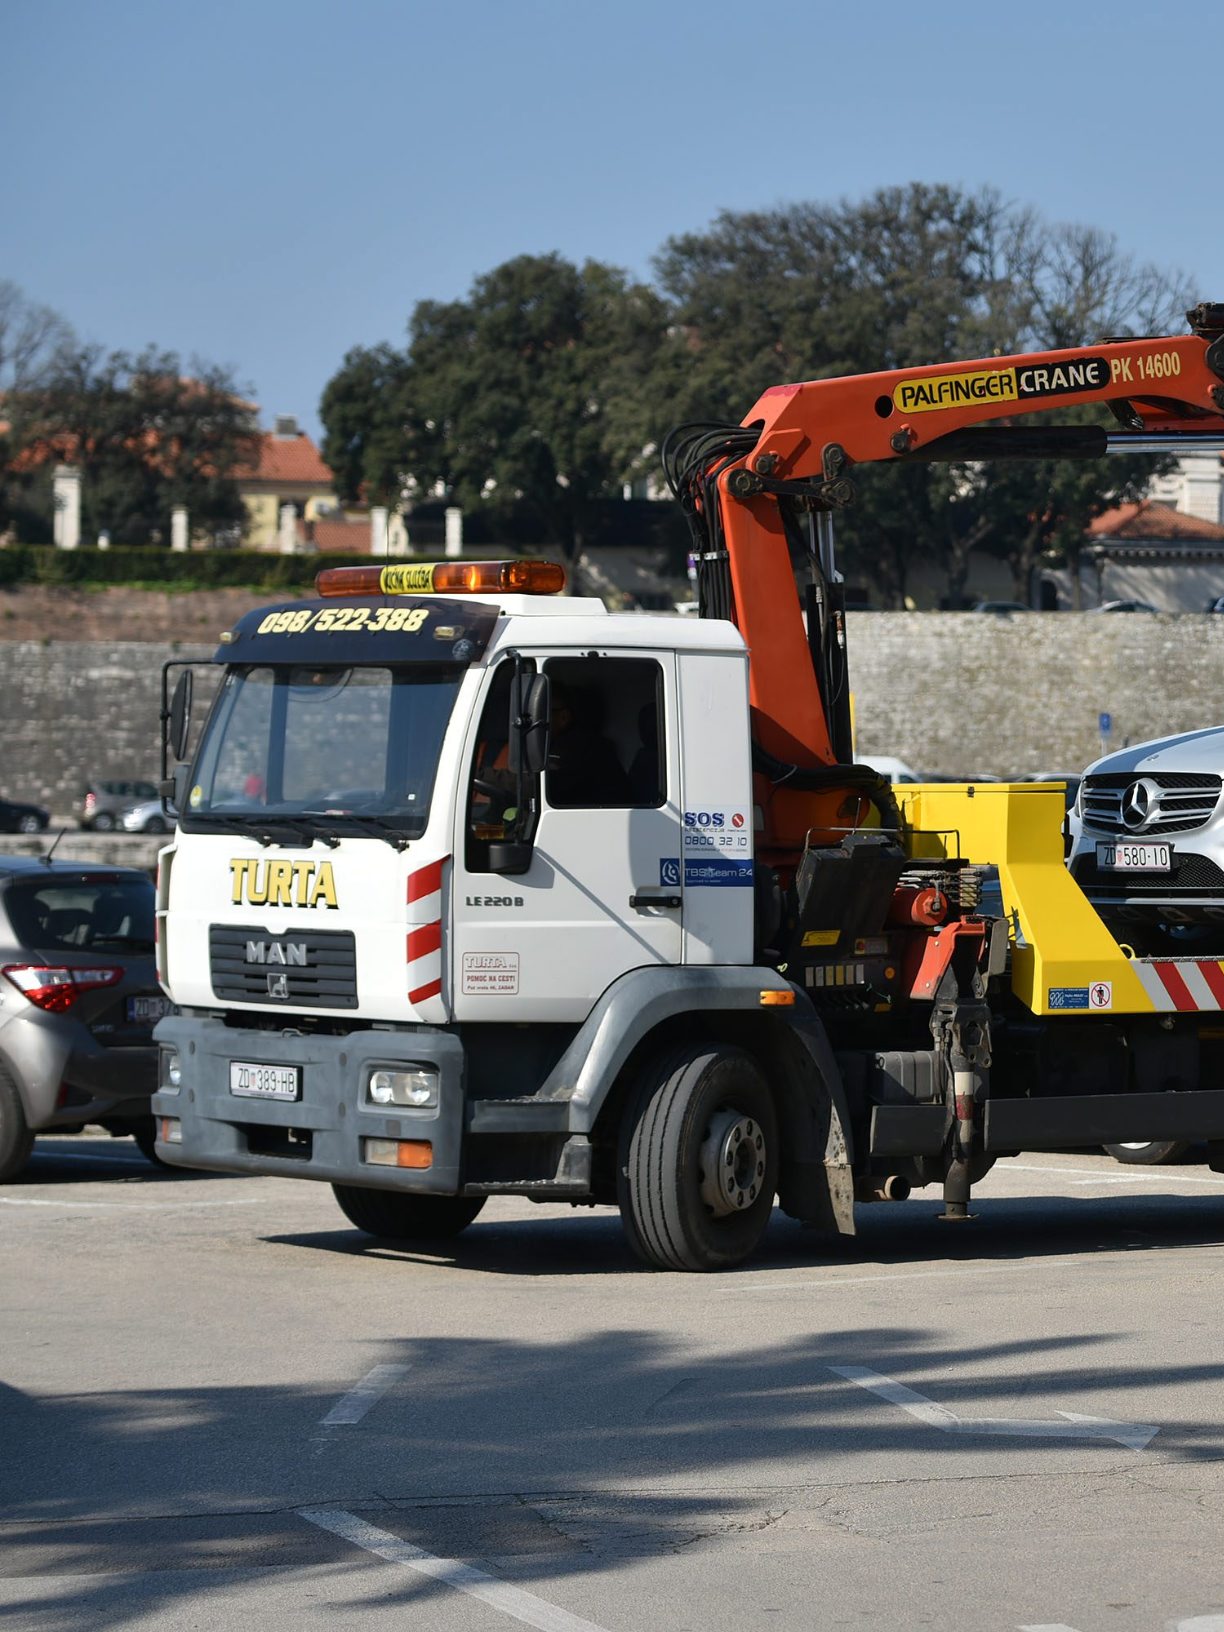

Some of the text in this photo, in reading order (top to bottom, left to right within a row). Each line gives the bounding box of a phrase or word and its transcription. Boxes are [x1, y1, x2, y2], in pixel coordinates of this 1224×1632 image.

[901, 351, 1181, 408] PALFINGER CRANE PK 14600
[257, 608, 429, 634] 098/522-388
[684, 812, 725, 827] SOS
[685, 836, 747, 846] 0800 32 10
[1104, 847, 1116, 865] ZD
[738, 868, 753, 877] 24
[230, 858, 339, 910] TURTA
[466, 896, 524, 906] LE 220 B
[246, 941, 307, 966] MAN
[465, 956, 507, 968] TURTA
[238, 1068, 249, 1088] ZD
